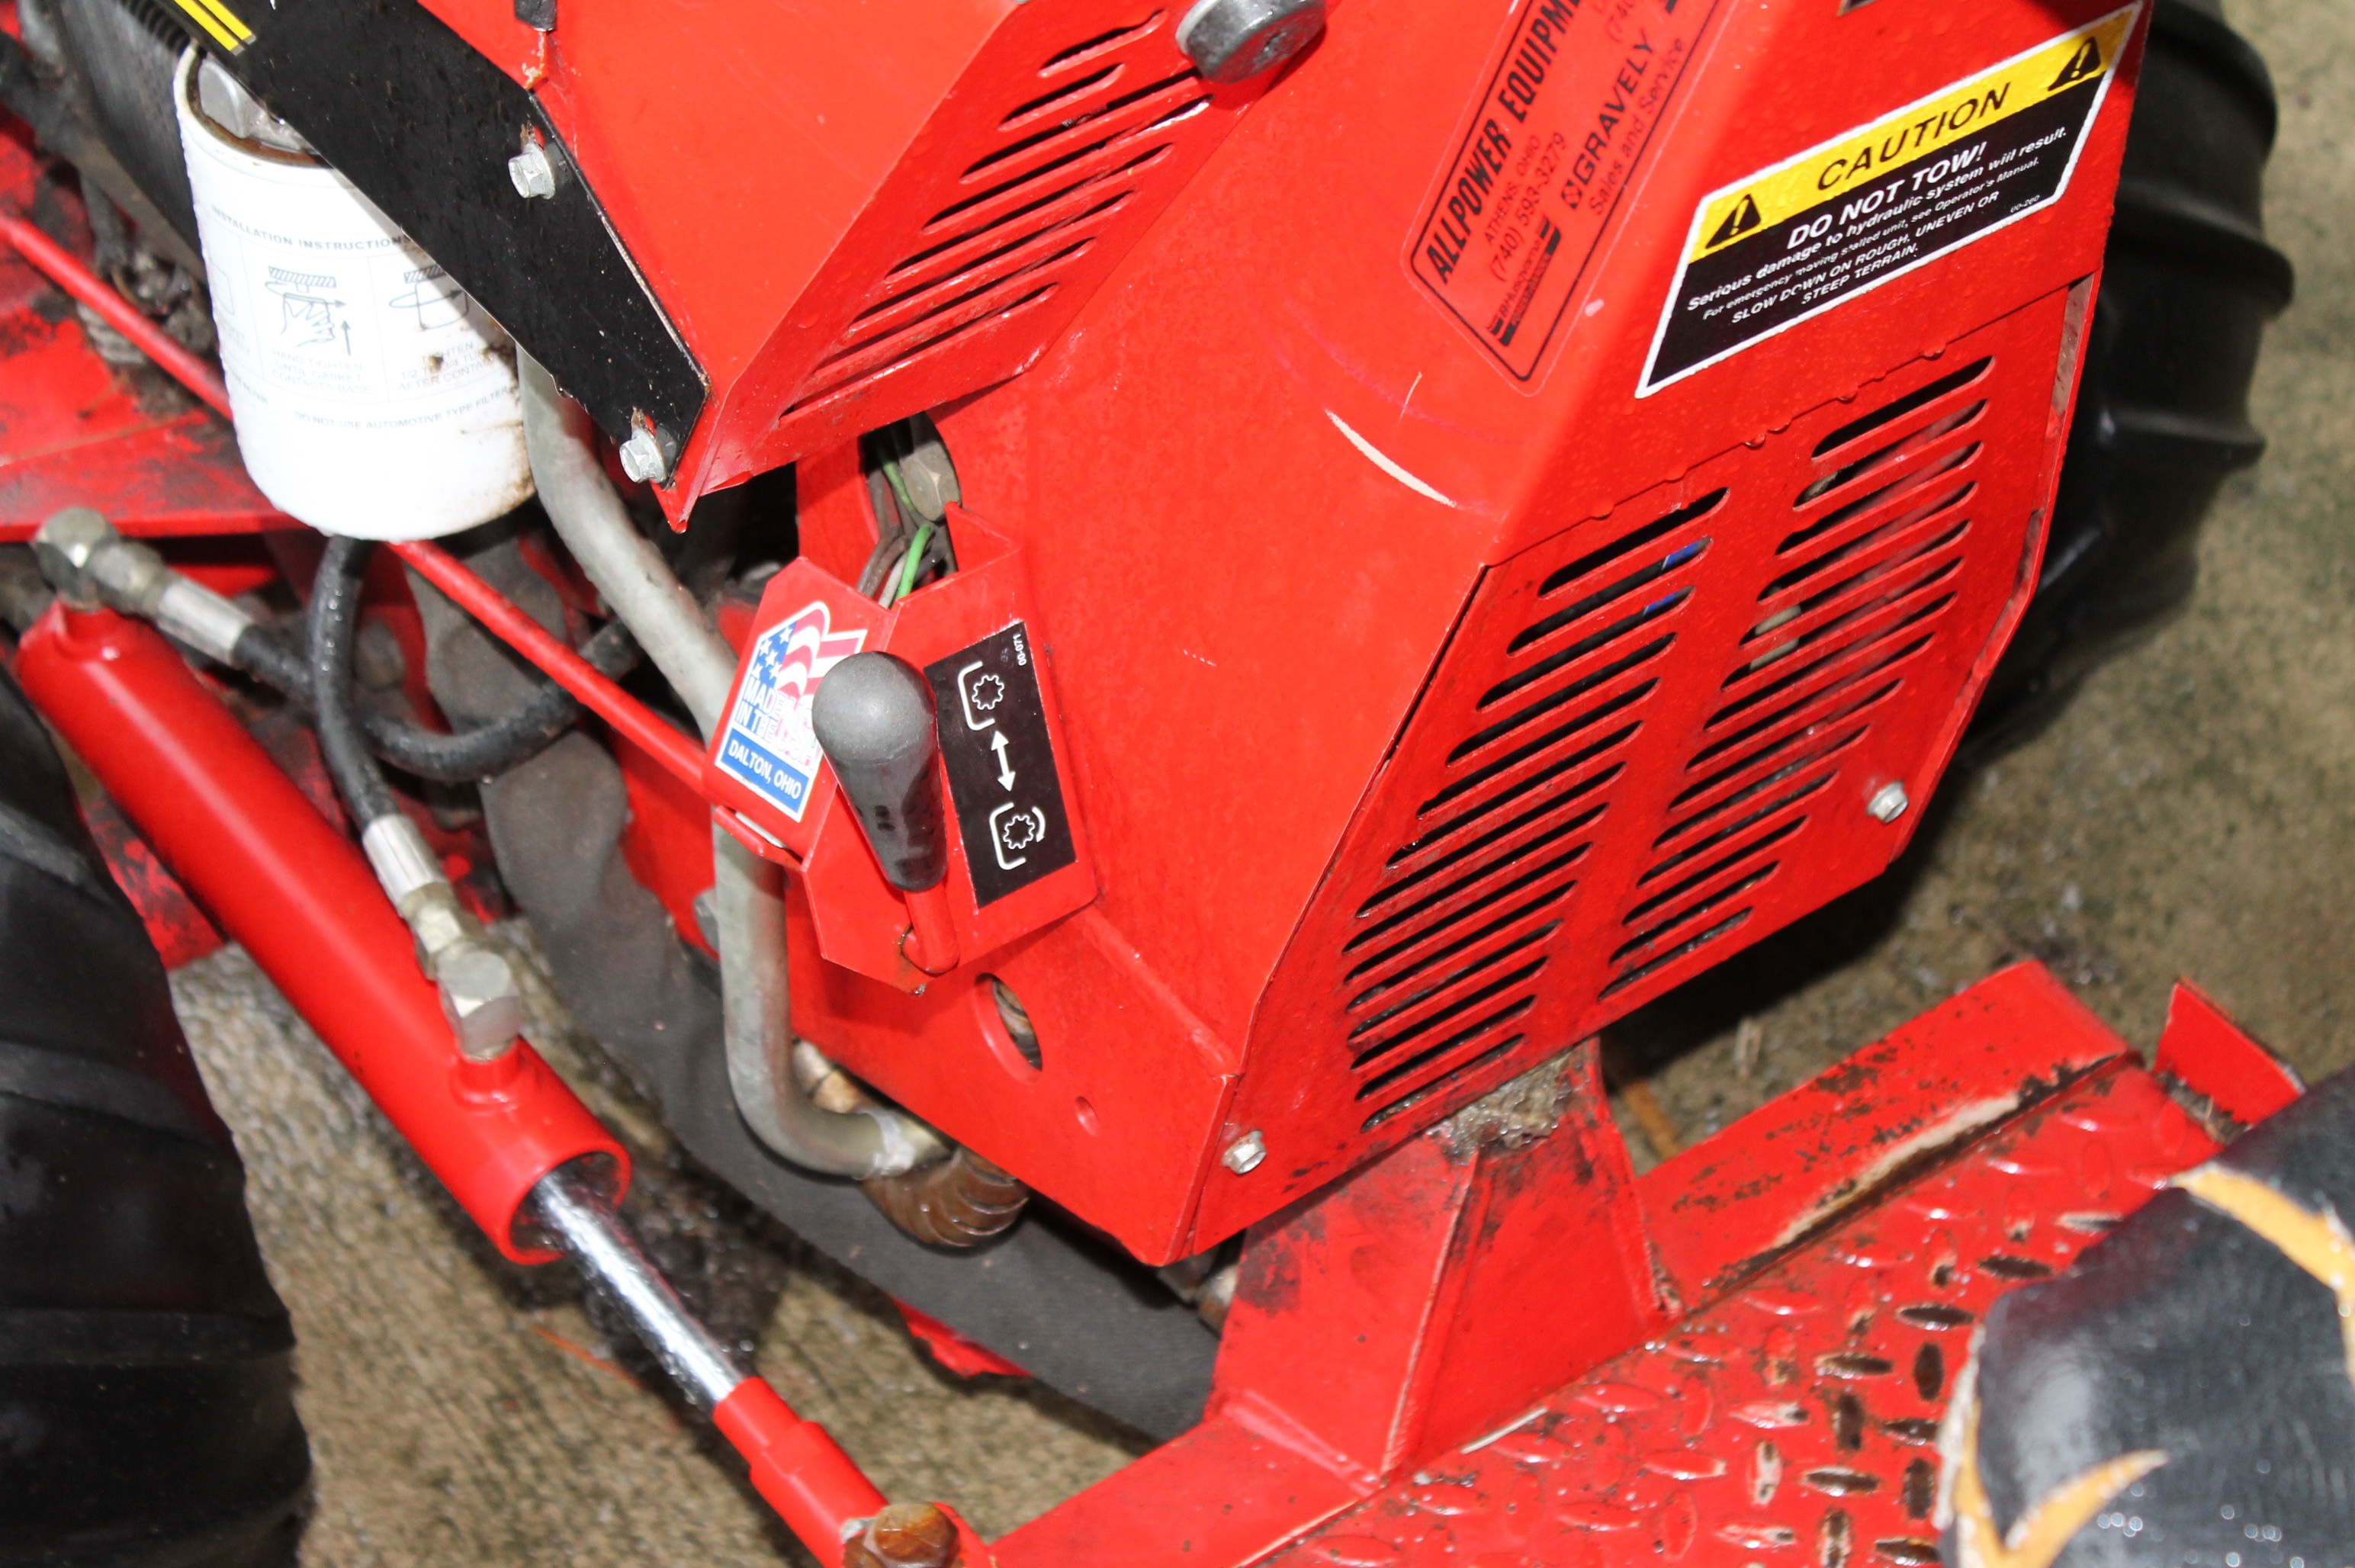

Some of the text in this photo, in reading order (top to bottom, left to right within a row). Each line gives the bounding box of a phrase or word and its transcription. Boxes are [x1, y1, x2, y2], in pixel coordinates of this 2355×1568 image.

[1572, 26, 1656, 187] GRAVELY
[1589, 37, 1686, 217] Sales and Service
[1425, 0, 1581, 285] ALLPOWER EQUIPM
[1515, 133, 1541, 178] OHIO
[1817, 81, 2012, 191] CAUTION
[1686, 127, 2067, 311] Serious damage to hydraulic system will result.
[1786, 141, 1987, 250] DO NOT TOW!
[210, 203, 293, 246] INSTALLATION
[1702, 305, 1724, 320] For
[1726, 273, 1794, 309] emergency
[1794, 252, 1839, 275] moving
[1882, 219, 1909, 236] unit,
[1910, 208, 1932, 223] see
[1934, 178, 1996, 212] Operator's
[1995, 156, 2040, 184] Manual.
[1489, 226, 1526, 283] (740)
[1731, 294, 1778, 324] SLOW
[1779, 272, 1827, 302] DOWN
[1829, 259, 1853, 278] ON
[1914, 201, 1975, 238] UNEVEN
[1977, 191, 2000, 209] OR
[1801, 242, 1919, 304] STEEP TERRAIN.
[271, 347, 363, 372] HAND TIGHTEN
[271, 368, 373, 395] CONTACTS BASE
[275, 360, 363, 383] UNTIL GASKET
[397, 374, 441, 392] AFTER
[294, 410, 310, 423] DO
[312, 416, 335, 426] NOT
[339, 420, 362, 430] USE
[365, 411, 442, 429] AUTOMOTIVE
[445, 402, 473, 418] TYPE
[1012, 633, 1027, 667] 00-071
[734, 699, 754, 728] IN
[751, 708, 780, 744] THE
[741, 673, 788, 722] MADE
[728, 738, 803, 800] DALTON, OHIO
